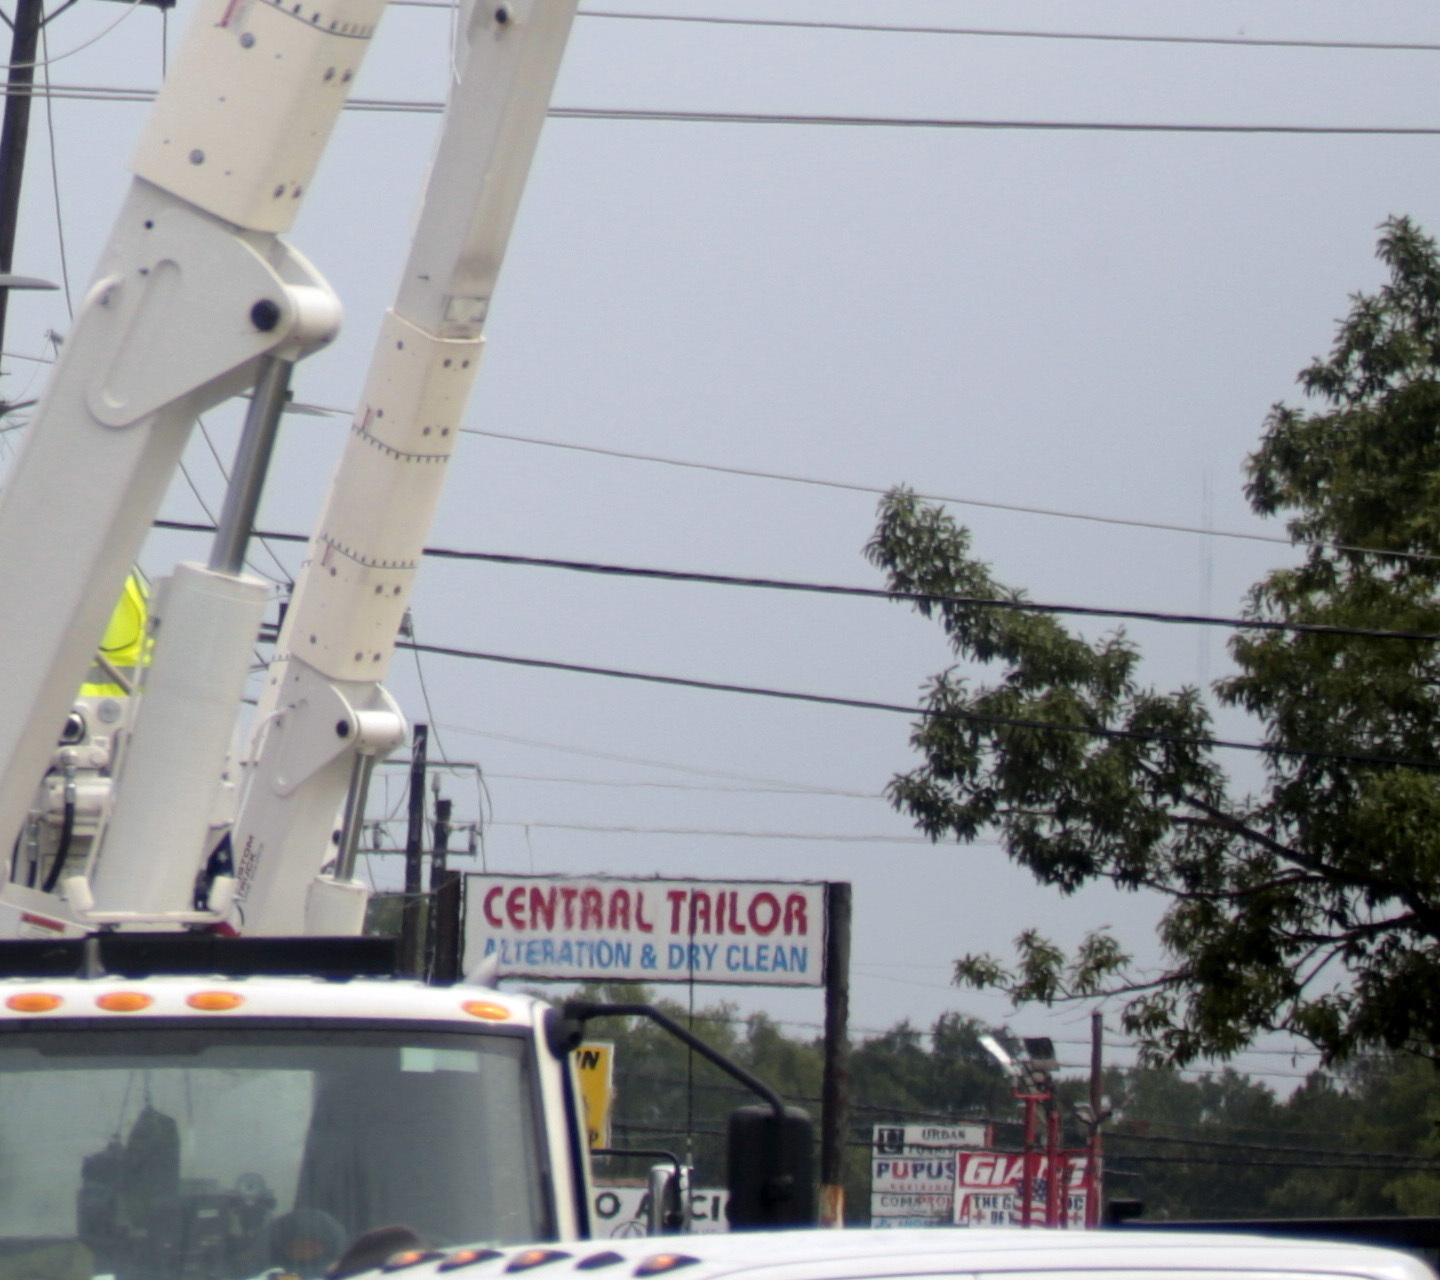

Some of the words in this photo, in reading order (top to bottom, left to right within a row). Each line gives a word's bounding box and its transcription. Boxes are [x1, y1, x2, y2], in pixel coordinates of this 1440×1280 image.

[483, 886, 653, 933] CENTRAL
[666, 889, 808, 936] TAILOR
[484, 938, 632, 969] ALTERATION
[640, 947, 657, 971] &
[668, 943, 716, 972] DRY
[725, 945, 808, 974] CLEAN
[922, 1128, 966, 1140] URBAN
